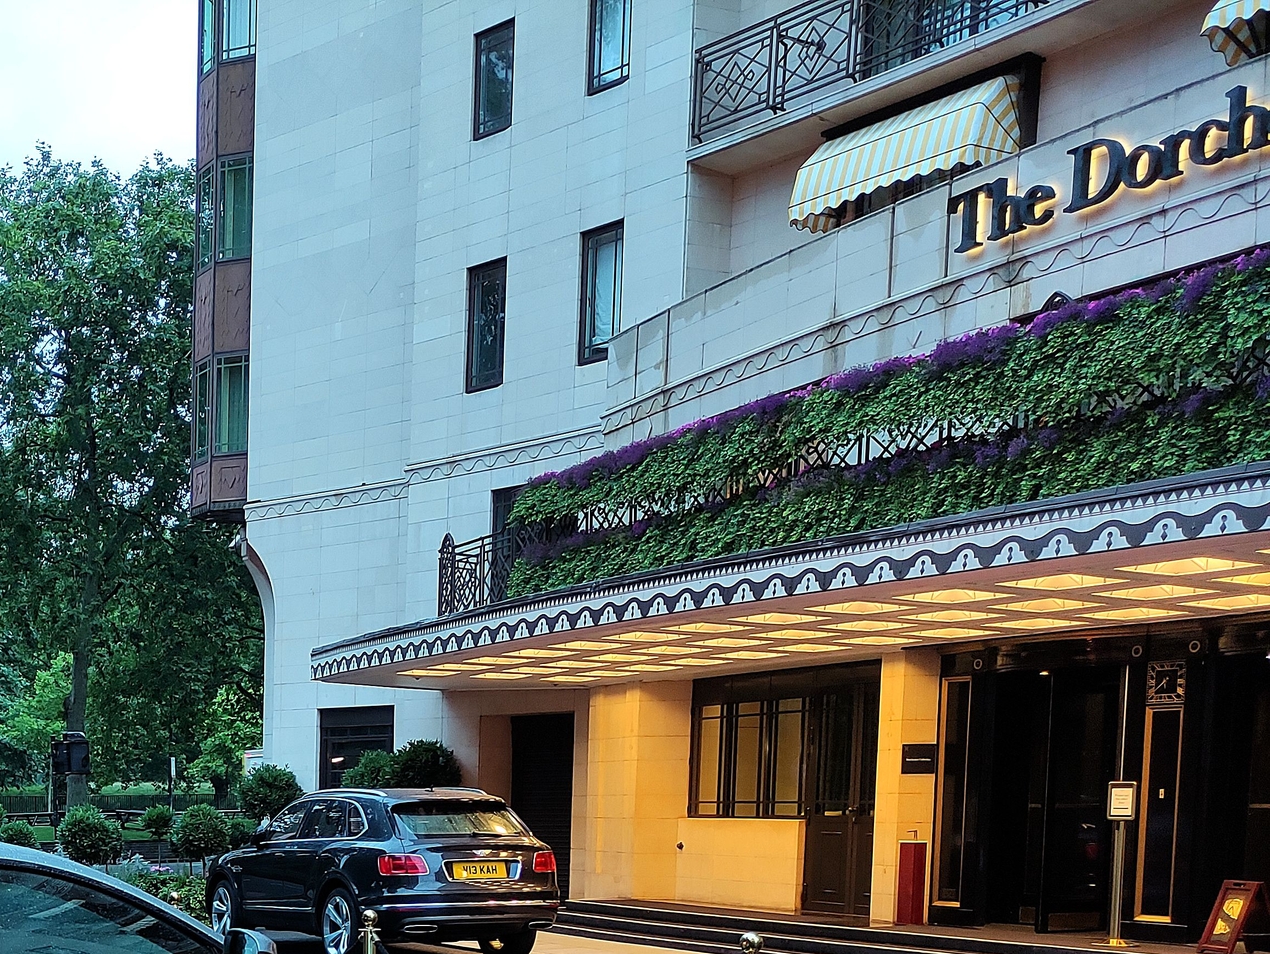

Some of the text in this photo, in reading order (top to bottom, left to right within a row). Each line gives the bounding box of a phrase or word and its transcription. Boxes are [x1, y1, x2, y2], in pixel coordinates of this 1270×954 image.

[947, 85, 1270, 254] The Dorch
[479, 864, 497, 875] KAH
